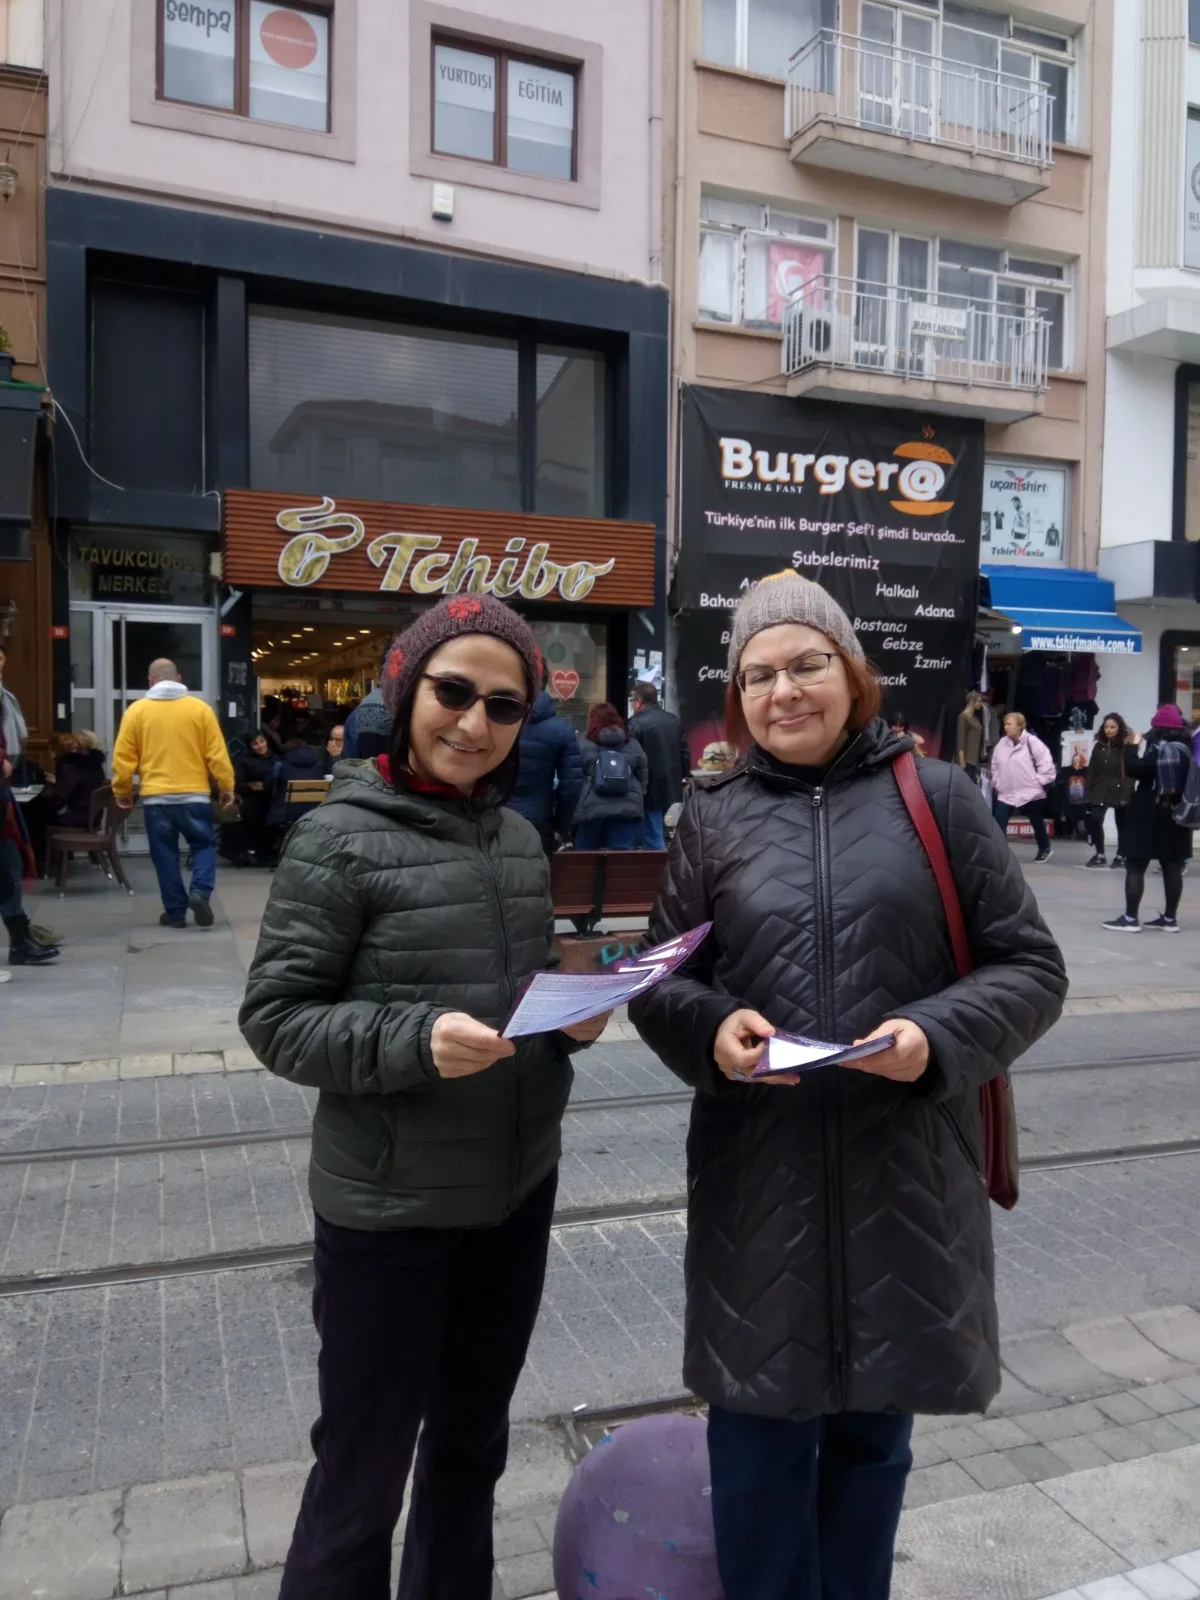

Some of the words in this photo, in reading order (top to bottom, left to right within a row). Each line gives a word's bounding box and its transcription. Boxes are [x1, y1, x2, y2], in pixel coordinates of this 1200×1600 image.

[166, 0, 231, 38] sempa
[439, 64, 492, 92] YURTDIŞI
[518, 77, 563, 106] EĞİTİM
[724, 480, 762, 491] FRESH
[764, 482, 772, 492] &
[775, 483, 803, 494] FAST
[705, 511, 776, 531] Türkiye'nin
[779, 517, 796, 531] ilk
[799, 518, 844, 536] Burger
[847, 520, 874, 536] Şef'i
[877, 526, 909, 540] şimdi
[912, 528, 965, 543] burada...
[367, 532, 615, 601] Tchibo
[792, 551, 880, 570] Şubelerimiz
[875, 582, 919, 598] Halkalı
[700, 592, 741, 608] Bahar
[914, 604, 955, 618] Adana
[853, 617, 907, 633] Bostancı
[882, 637, 924, 651] Gebze
[1031, 635, 1135, 652] www.tshirtmania.com.tr
[913, 653, 952, 669] İzmir
[874, 673, 907, 686] vacık
